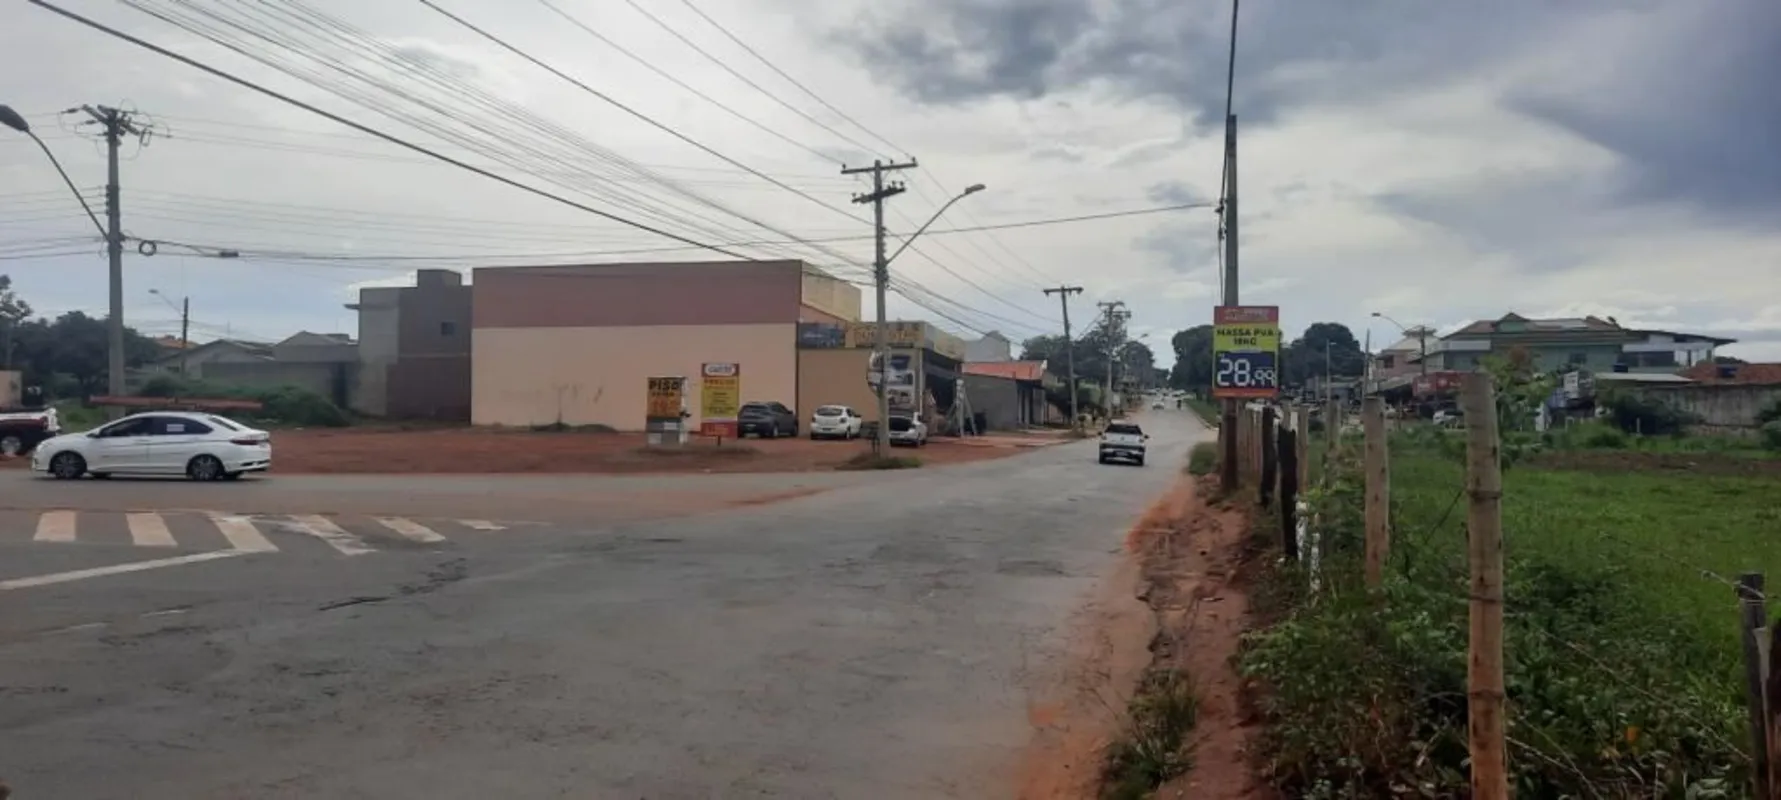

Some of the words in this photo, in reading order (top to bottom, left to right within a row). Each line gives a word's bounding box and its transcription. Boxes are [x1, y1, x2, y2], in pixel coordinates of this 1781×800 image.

[1217, 328, 1251, 336] MASSA
[1253, 328, 1275, 336] PVA
[649, 379, 680, 390] PISO
